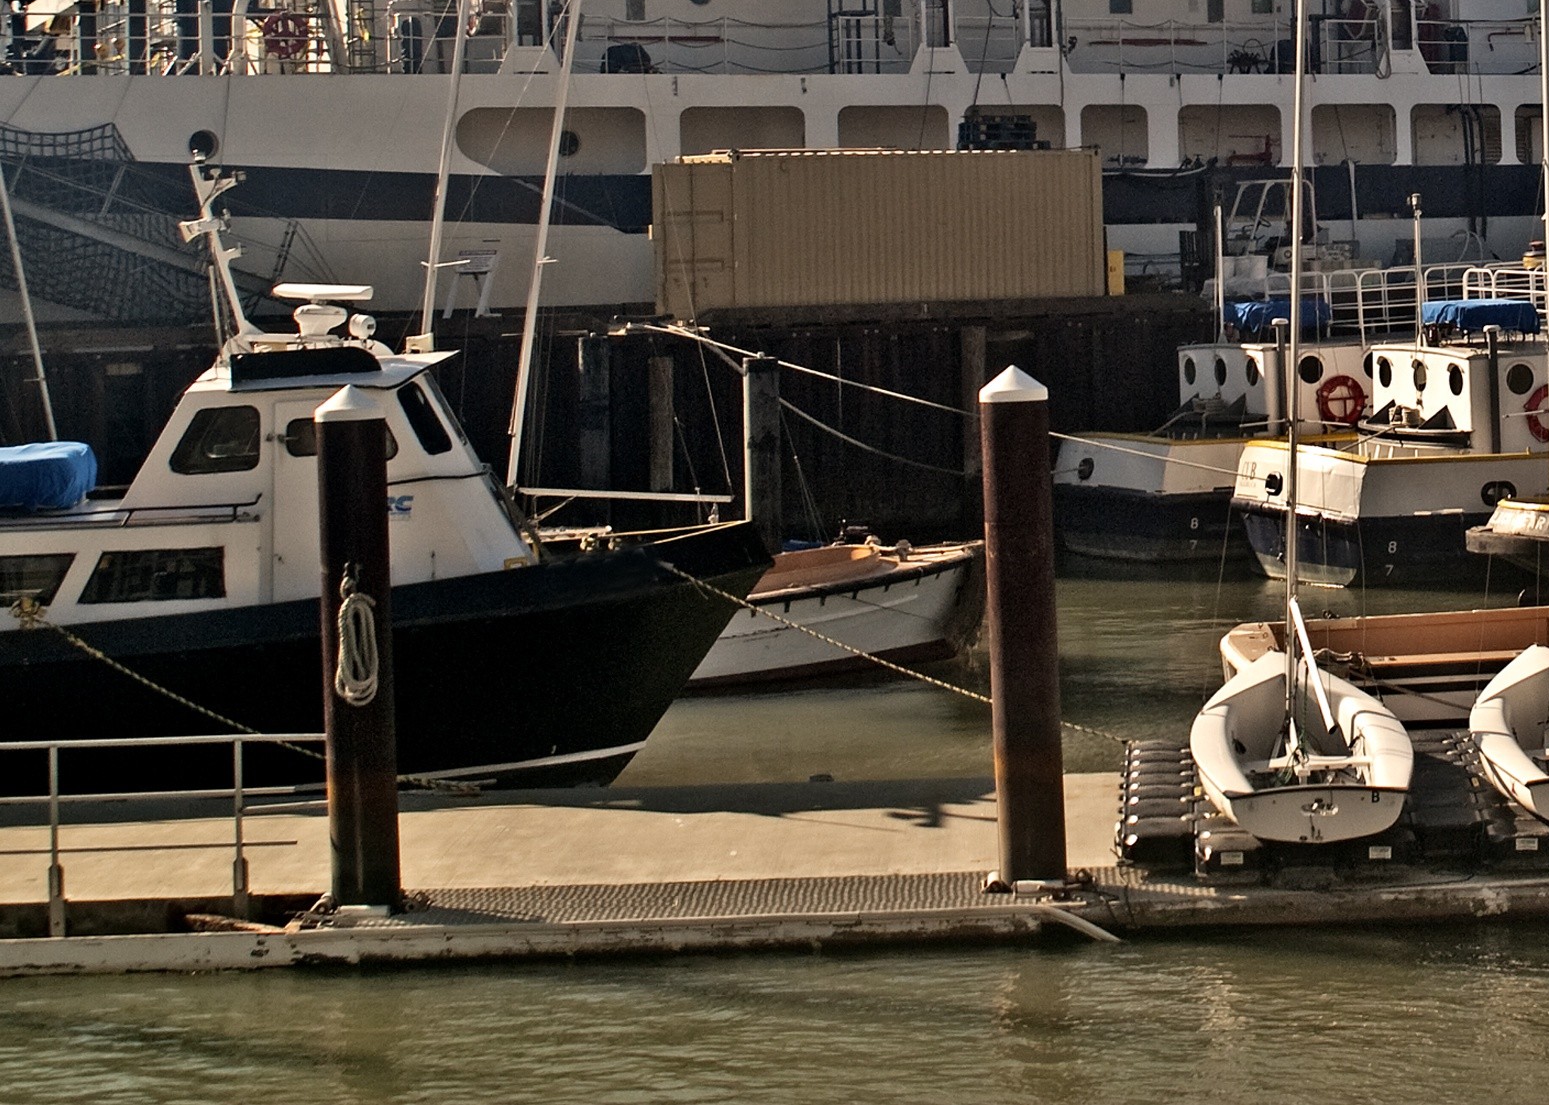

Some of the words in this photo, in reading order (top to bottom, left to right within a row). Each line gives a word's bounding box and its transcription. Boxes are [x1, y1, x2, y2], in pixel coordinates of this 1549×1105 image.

[1190, 517, 1199, 529] 8
[1190, 539, 1198, 550] 7
[1388, 541, 1397, 553] 8
[1385, 564, 1394, 576] 7
[1371, 790, 1380, 803] B
